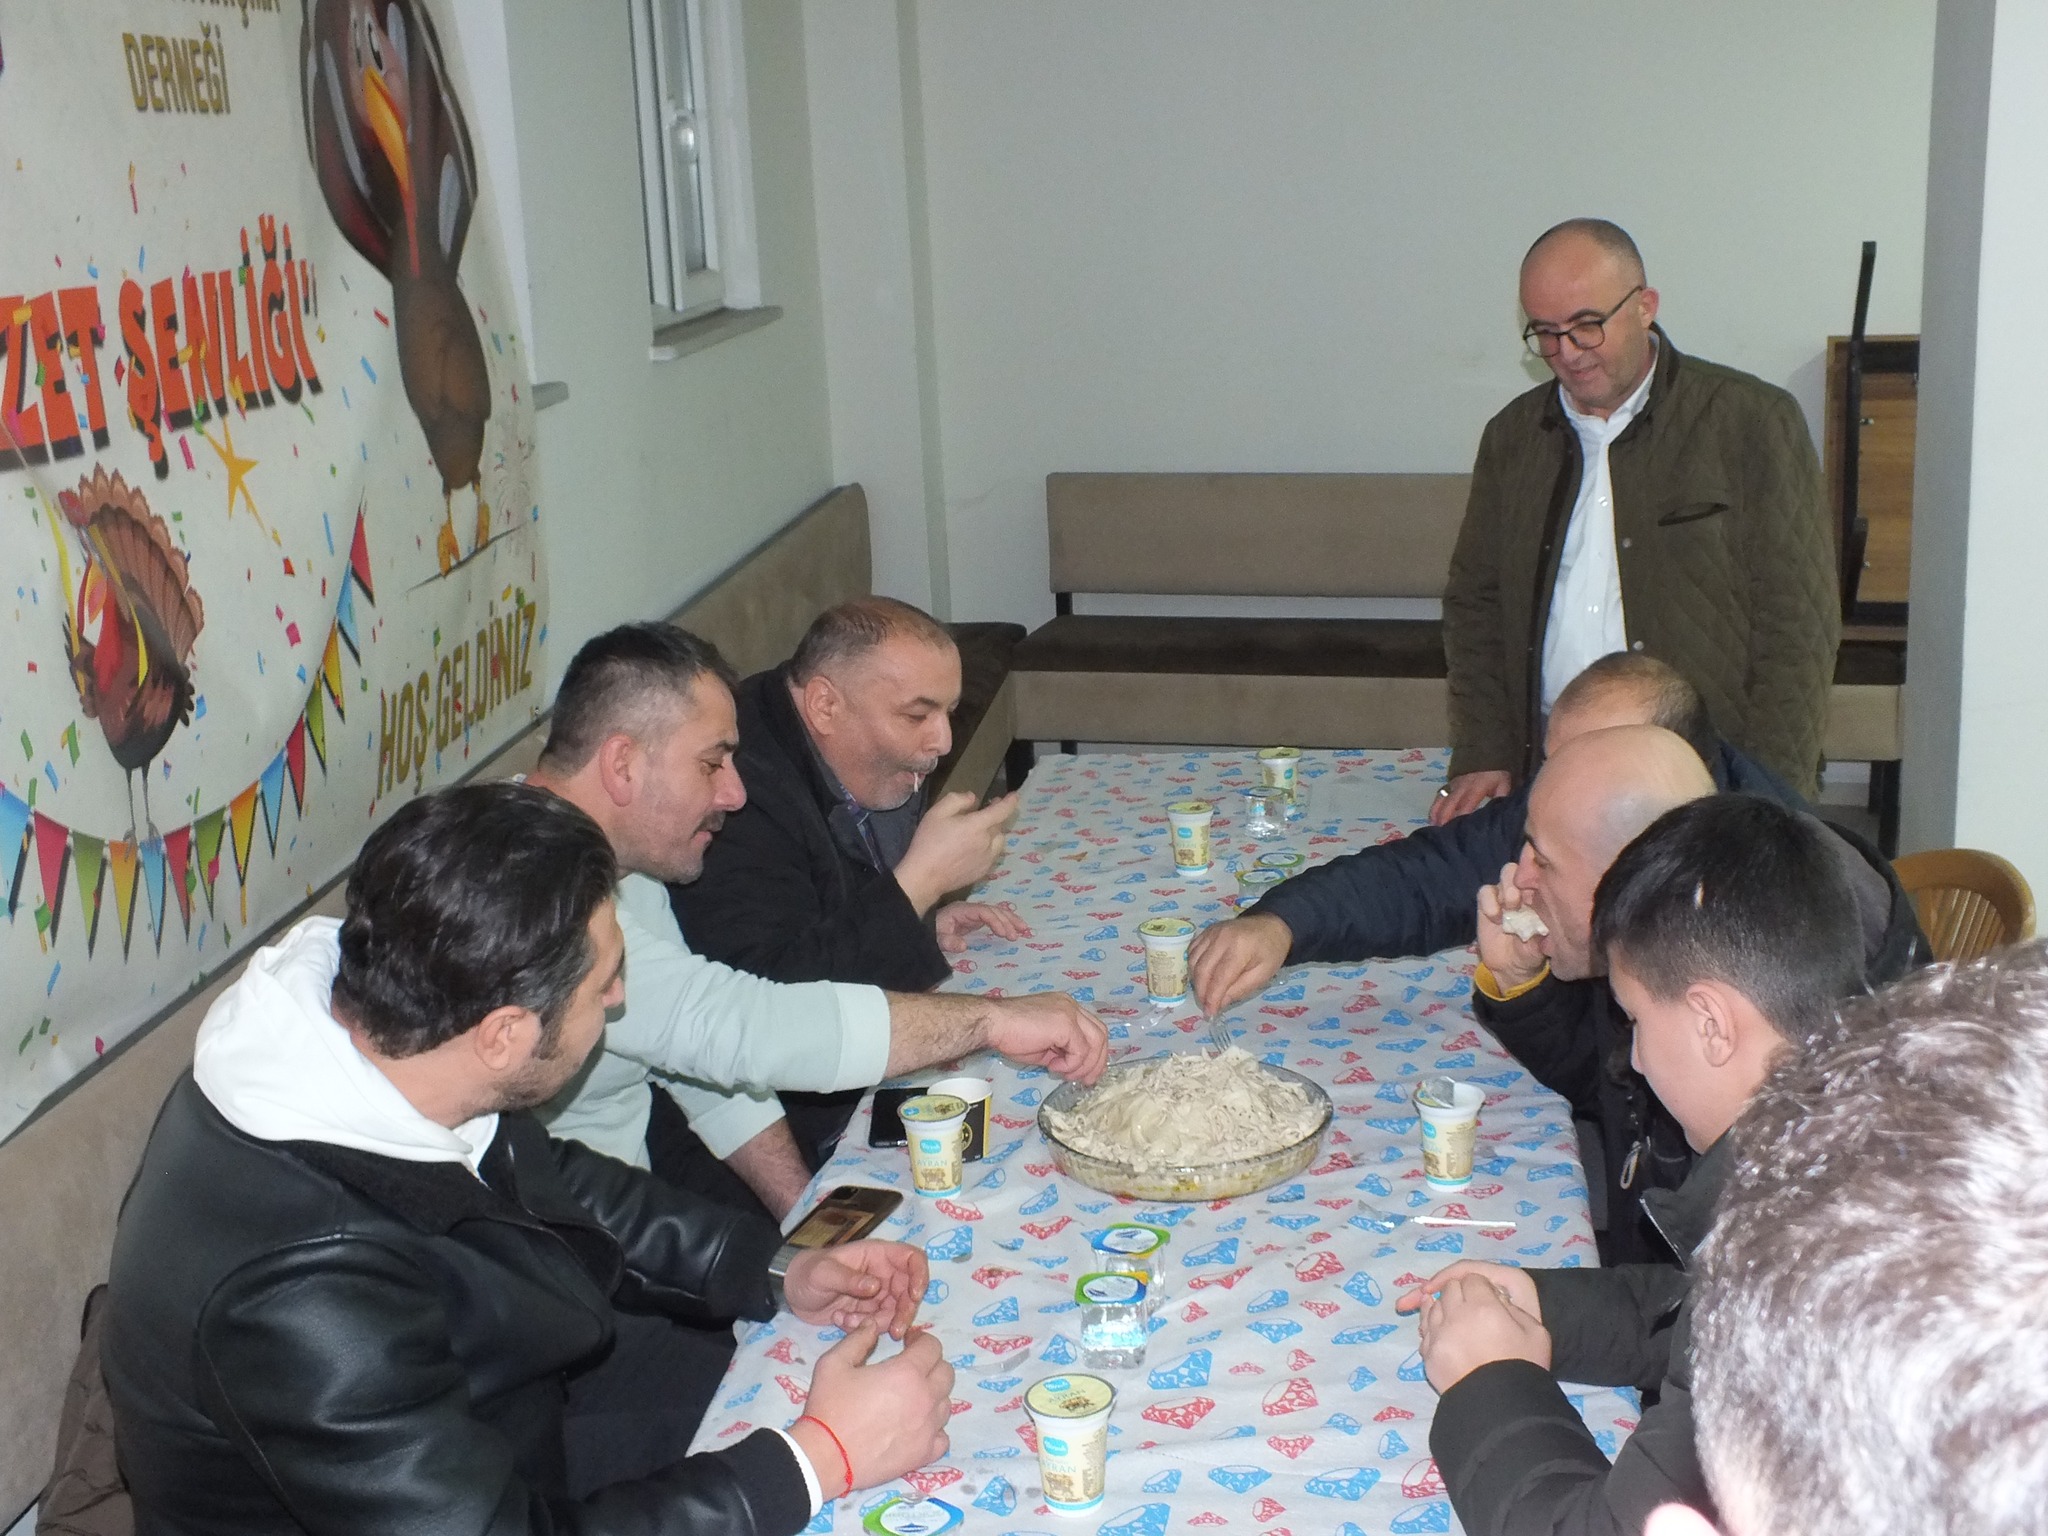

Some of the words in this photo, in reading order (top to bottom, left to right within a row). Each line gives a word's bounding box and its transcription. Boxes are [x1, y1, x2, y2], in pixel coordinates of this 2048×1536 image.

[122, 21, 231, 115] DERNEĞİ
[377, 671, 430, 800] HOŞ
[436, 600, 536, 752] GELDİNİZ
